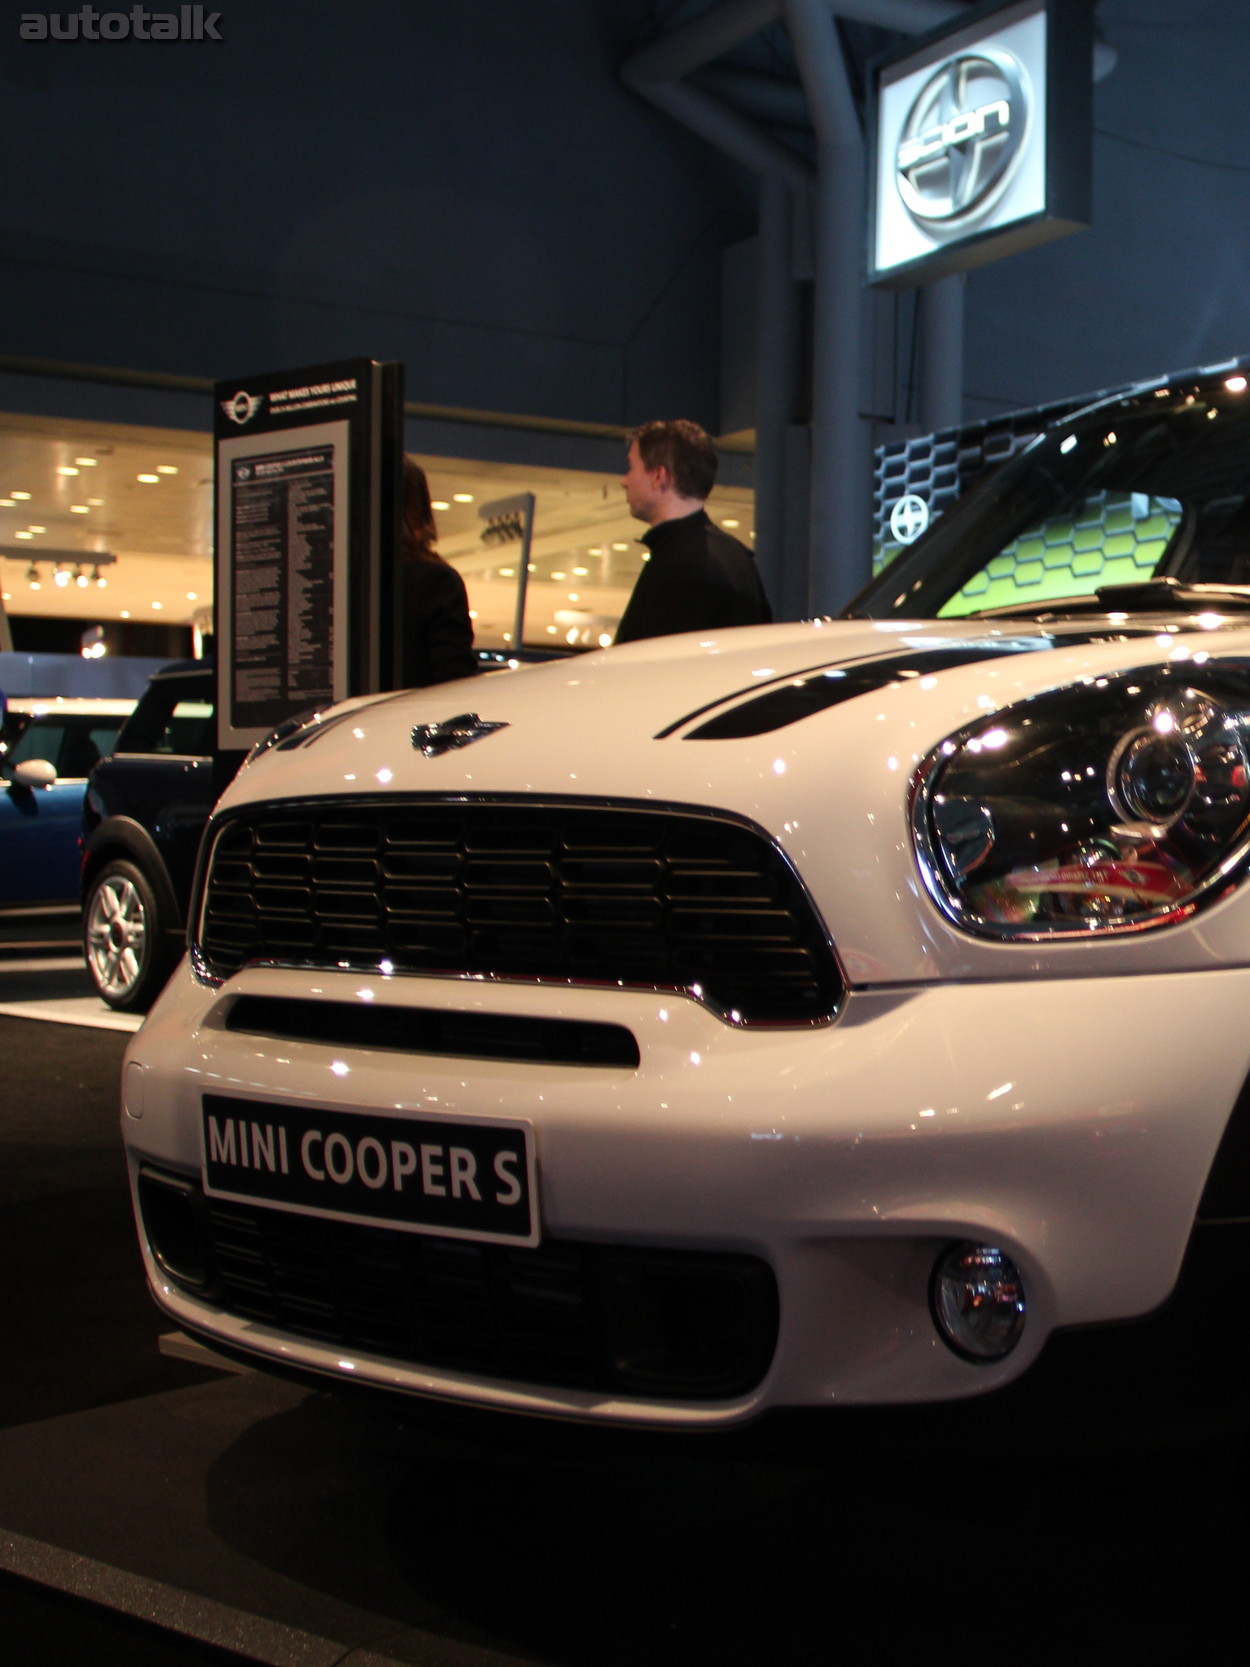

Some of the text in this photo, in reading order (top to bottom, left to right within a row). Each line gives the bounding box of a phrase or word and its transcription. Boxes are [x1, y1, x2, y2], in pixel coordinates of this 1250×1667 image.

[208, 1114, 522, 1206] MINI COOPER S
